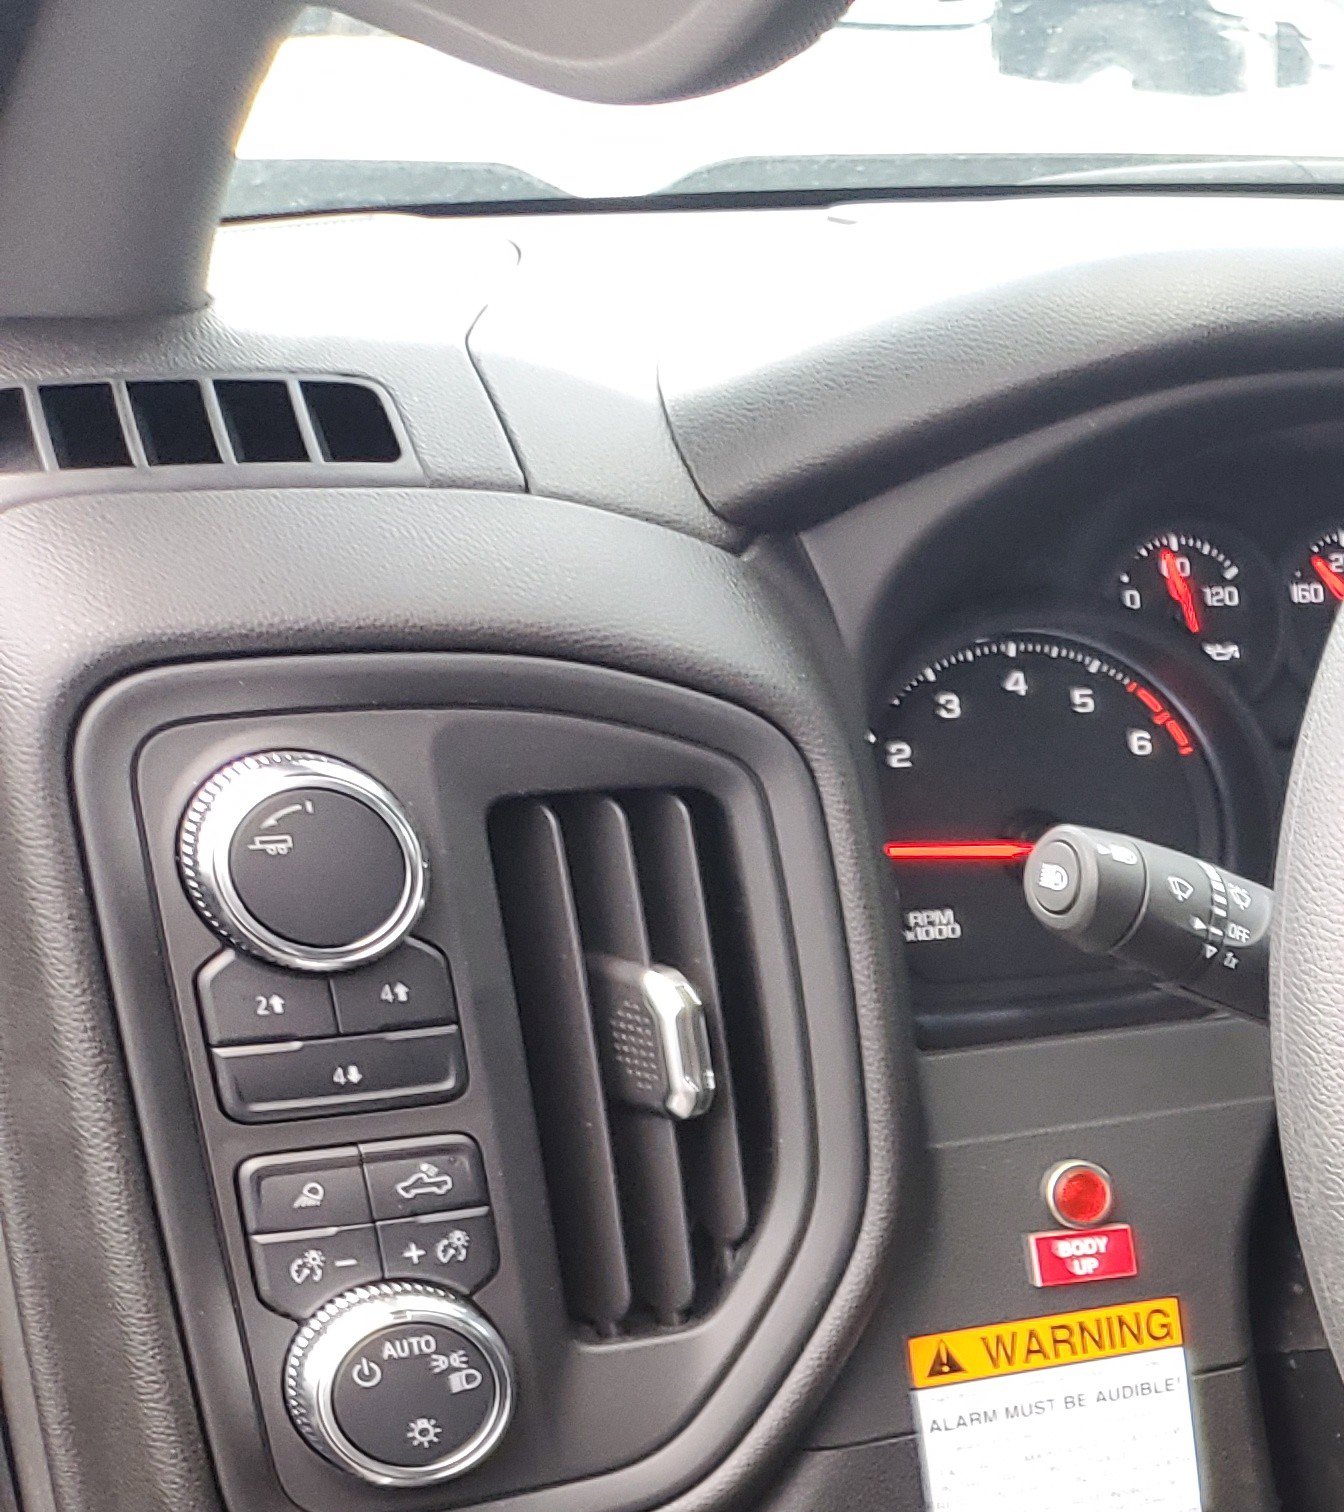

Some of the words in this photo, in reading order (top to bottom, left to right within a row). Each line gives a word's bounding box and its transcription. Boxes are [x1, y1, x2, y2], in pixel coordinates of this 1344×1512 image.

[1122, 589, 1141, 610] 0
[1202, 585, 1239, 607] 120
[1290, 582, 1324, 604] 160
[1003, 671, 1029, 697] 4
[935, 691, 962, 719] 3
[1069, 687, 1095, 715] 5
[887, 741, 913, 768] 2
[1127, 730, 1153, 757] 6
[906, 909, 954, 927] RPM
[1227, 922, 1251, 943] OFF
[380, 982, 393, 1002] 4
[256, 995, 269, 1016] 2
[333, 1065, 346, 1085] 4
[1053, 1235, 1108, 1258] BODY
[1070, 1256, 1100, 1276] UP
[382, 1335, 437, 1360] AUTO
[981, 1308, 1172, 1369] WARNING
[929, 1408, 998, 1434] ALARM
[1004, 1398, 1056, 1421] MUST
[1064, 1393, 1087, 1411] BE
